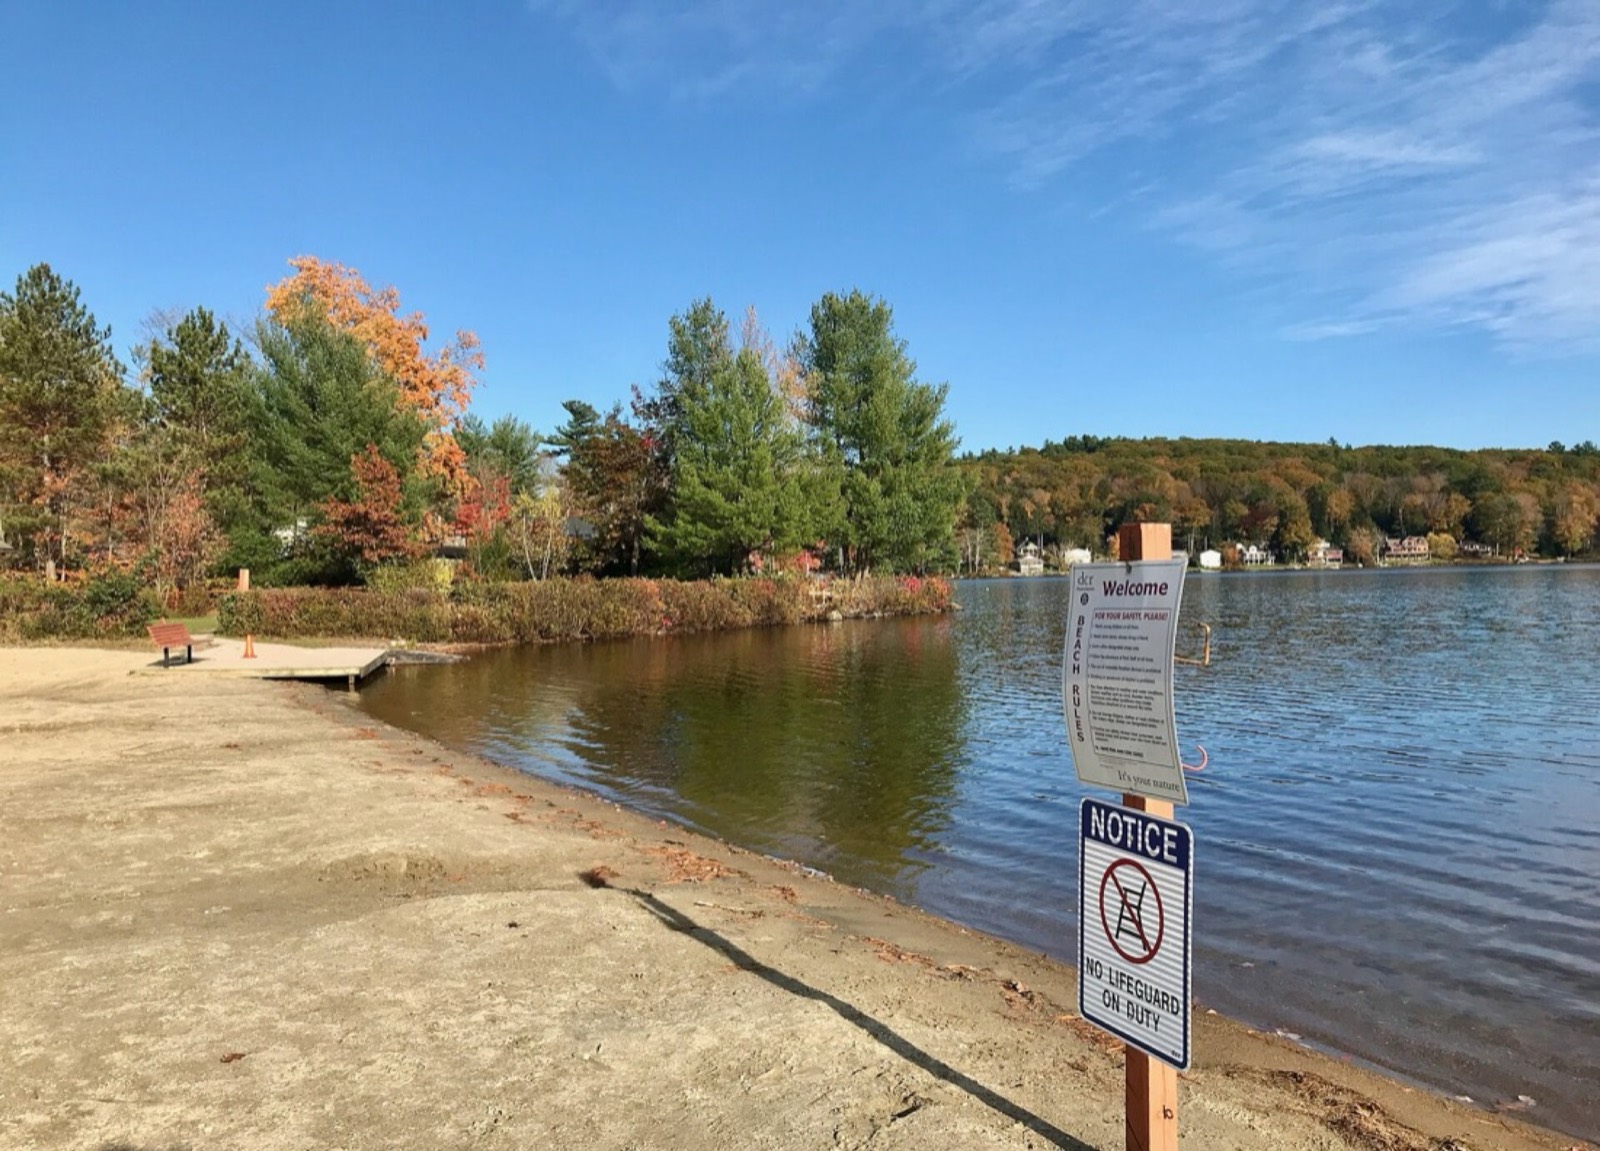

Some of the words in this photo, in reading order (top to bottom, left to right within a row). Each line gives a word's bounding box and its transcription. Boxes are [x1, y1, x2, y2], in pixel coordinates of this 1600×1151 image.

[1103, 579, 1169, 597] Welcome
[1094, 612, 1106, 620] FOR
[1106, 612, 1121, 620] YOUR
[1072, 615, 1085, 675] BEACH
[1072, 685, 1085, 742] RULES
[1132, 775, 1151, 786] your
[1152, 778, 1181, 791] nature
[1090, 805, 1178, 863] NOTICE
[1086, 956, 1103, 980] NO
[1108, 966, 1180, 1016] LIFEGUARD
[1102, 989, 1120, 1015] ON
[1126, 999, 1161, 1033] DUTY
